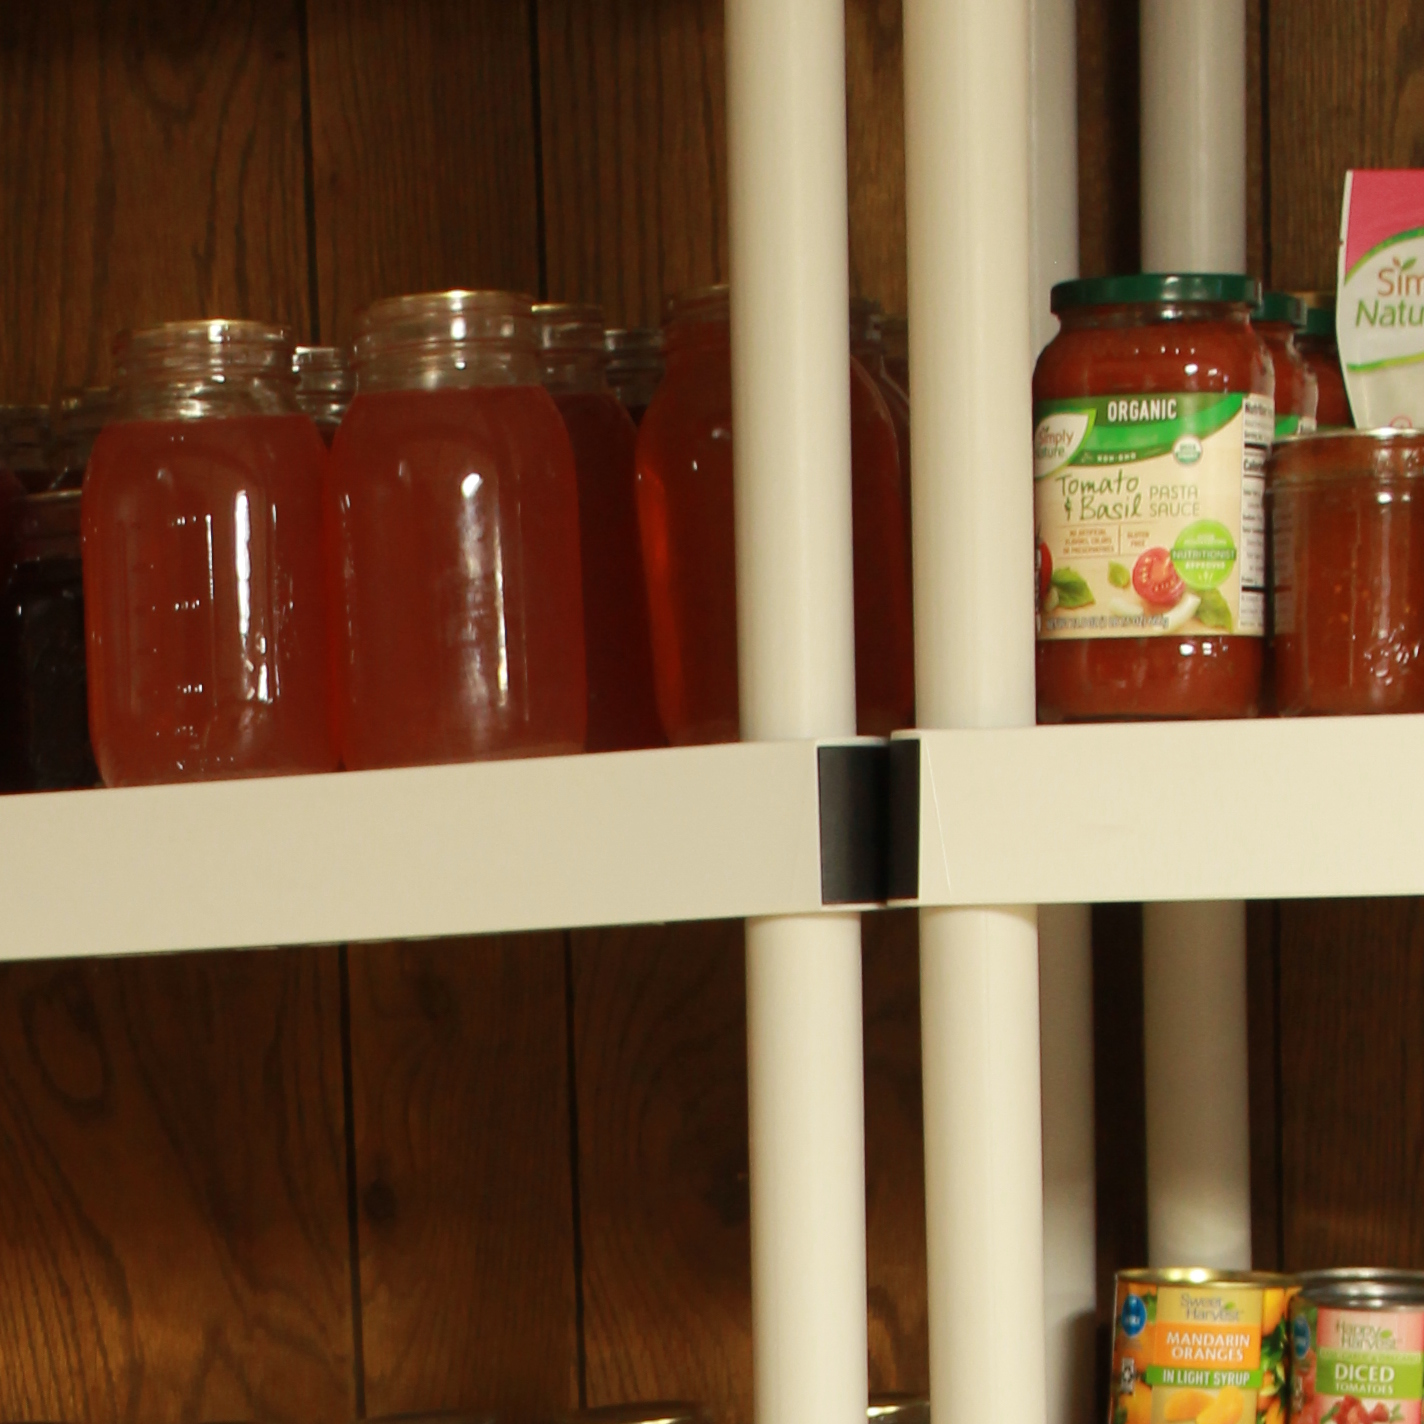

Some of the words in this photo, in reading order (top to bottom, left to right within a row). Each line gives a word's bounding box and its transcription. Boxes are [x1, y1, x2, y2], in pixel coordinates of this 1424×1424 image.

[1107, 399, 1177, 422] ORGANIC
[1055, 469, 1139, 495] Tomato
[1150, 485, 1198, 500] PASTA
[1079, 494, 1142, 520] Basil
[1150, 502, 1200, 517] SAUCE
[1186, 1308, 1239, 1322] Harvest
[1167, 1332, 1250, 1347] MANDARIN
[1172, 1348, 1243, 1362] ORANGES
[1163, 1369, 1174, 1383] IN
[1177, 1370, 1210, 1385] LIGHT
[1213, 1372, 1250, 1386] SYRUP
[1335, 1364, 1394, 1383] DICED
[1336, 1383, 1394, 1395] TOMATOES
